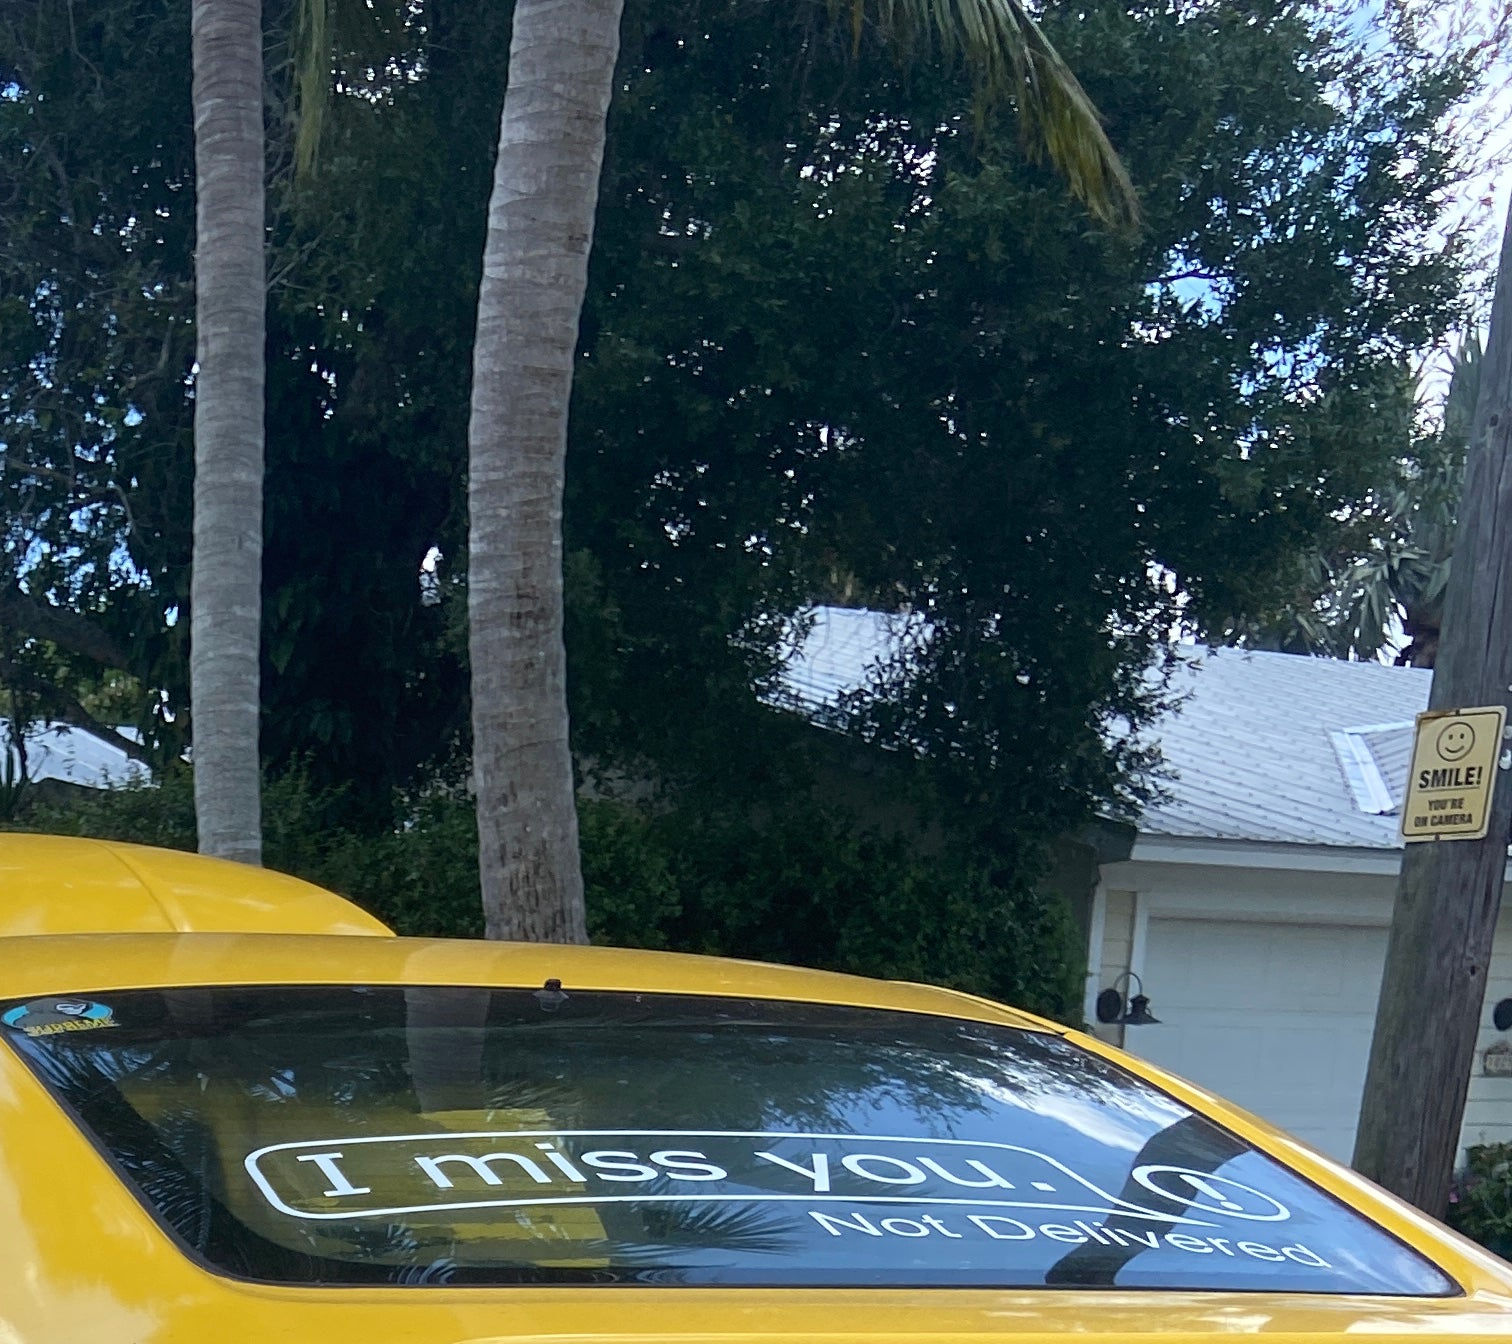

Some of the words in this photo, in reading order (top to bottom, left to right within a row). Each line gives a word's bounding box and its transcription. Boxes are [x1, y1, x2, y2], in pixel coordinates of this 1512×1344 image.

[1419, 767, 1483, 789] SMILE!
[1429, 798, 1464, 811] YOU'RE
[1415, 816, 1428, 827] ON
[1431, 814, 1472, 826] CAMERA
[296, 1152, 372, 1198] I
[414, 1142, 728, 1188] miss
[754, 1151, 1057, 1192] you.
[807, 1210, 963, 1239] Not
[966, 1213, 1333, 1268] Delivered
